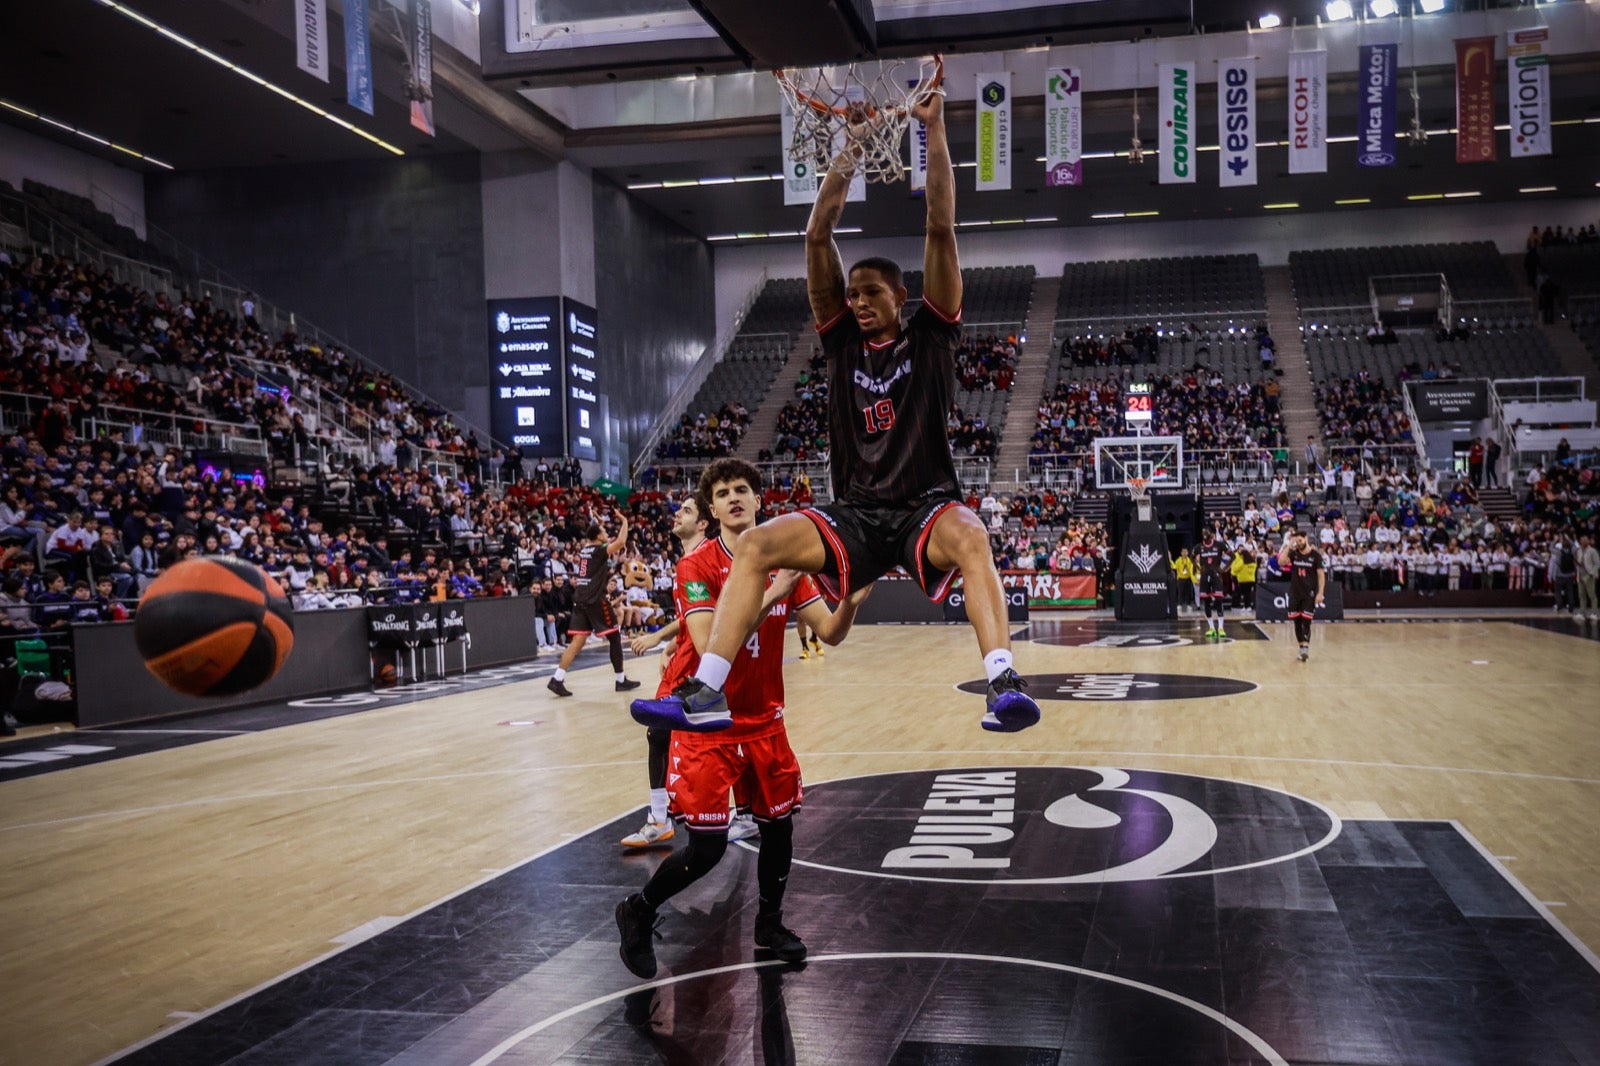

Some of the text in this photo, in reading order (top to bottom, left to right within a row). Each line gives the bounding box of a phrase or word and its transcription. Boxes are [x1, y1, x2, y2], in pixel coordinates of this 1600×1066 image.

[1367, 46, 1383, 103] Motor
[1514, 67, 1539, 136] orion
[1048, 108, 1058, 156] Deportes
[1060, 107, 1070, 160] Palacio de
[1226, 68, 1248, 152] asisa
[1295, 77, 1308, 150] RICOH
[1366, 106, 1382, 152] Mica
[1481, 80, 1491, 158] ANTONIO
[999, 110, 1008, 166] cidesur
[508, 341, 549, 353] emasagra
[863, 398, 896, 434] 19
[1128, 396, 1149, 412] 24
[746, 631, 760, 658] 4
[881, 771, 1017, 868] PULEVA
